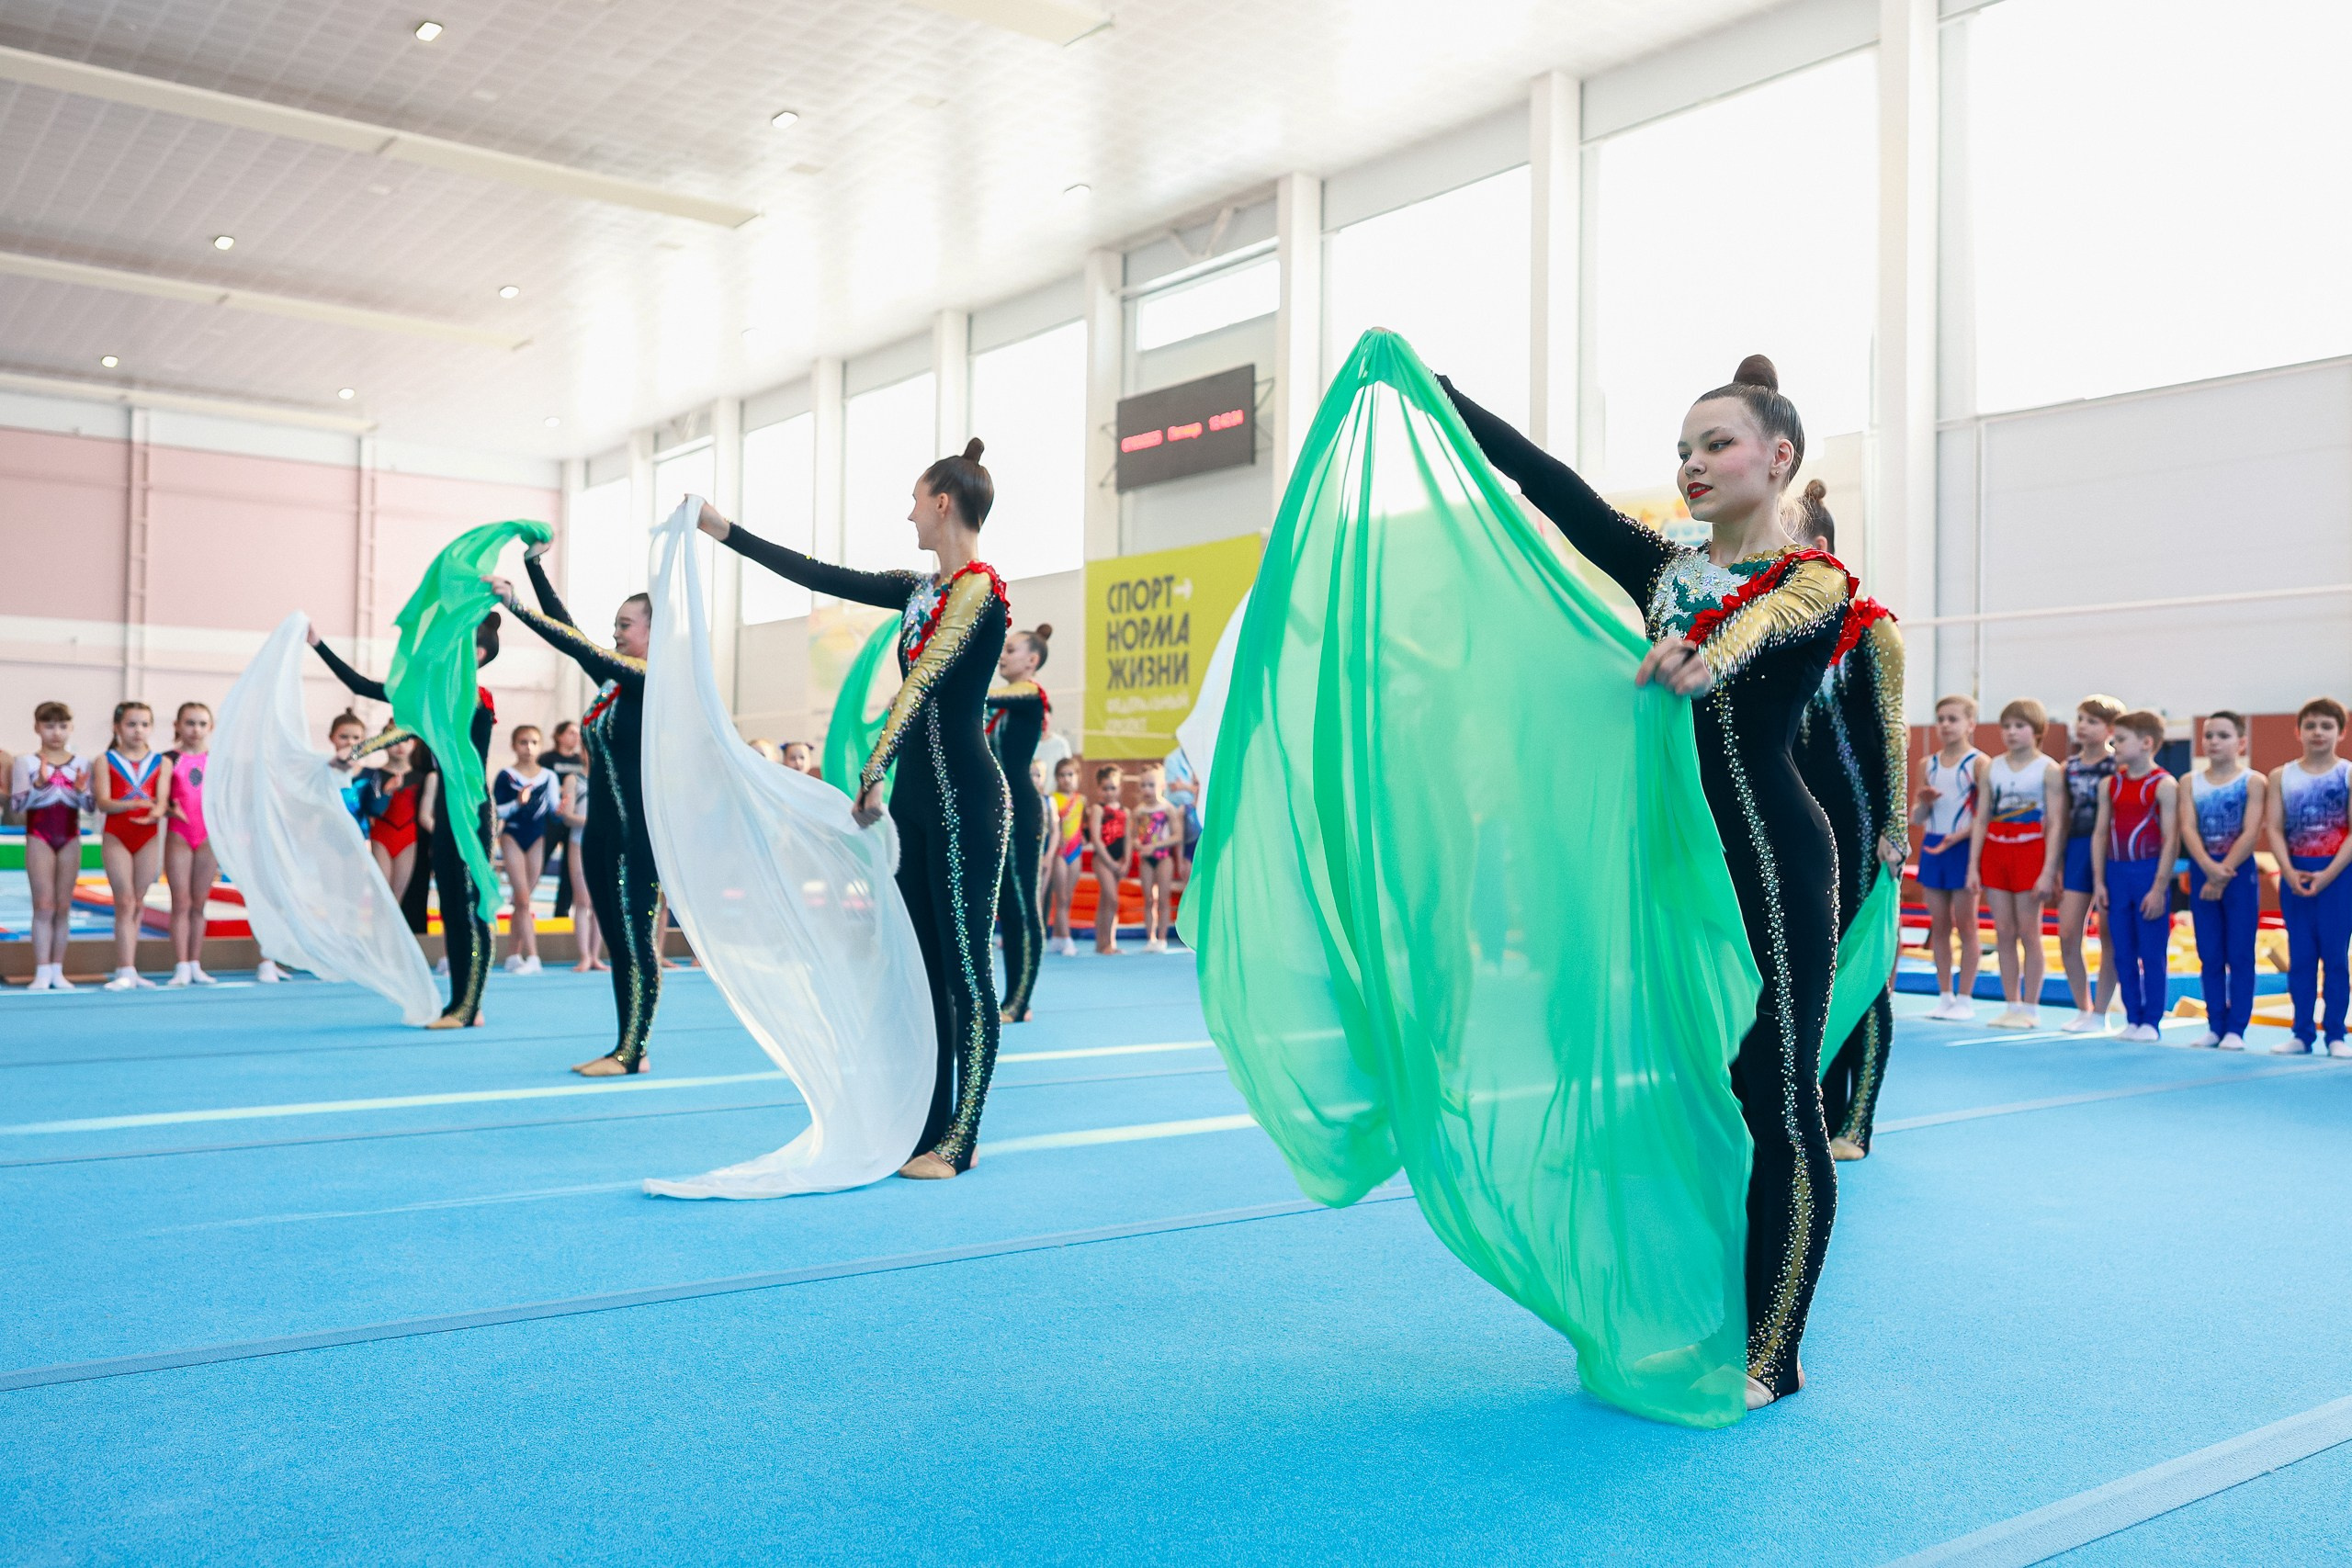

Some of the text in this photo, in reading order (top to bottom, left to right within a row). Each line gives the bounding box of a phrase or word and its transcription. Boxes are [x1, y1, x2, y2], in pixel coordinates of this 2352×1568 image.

[1107, 575, 1174, 614] СПОРТ
[1106, 613, 1190, 652] НОРМА
[1106, 651, 1189, 690] ЖИЗНИ
